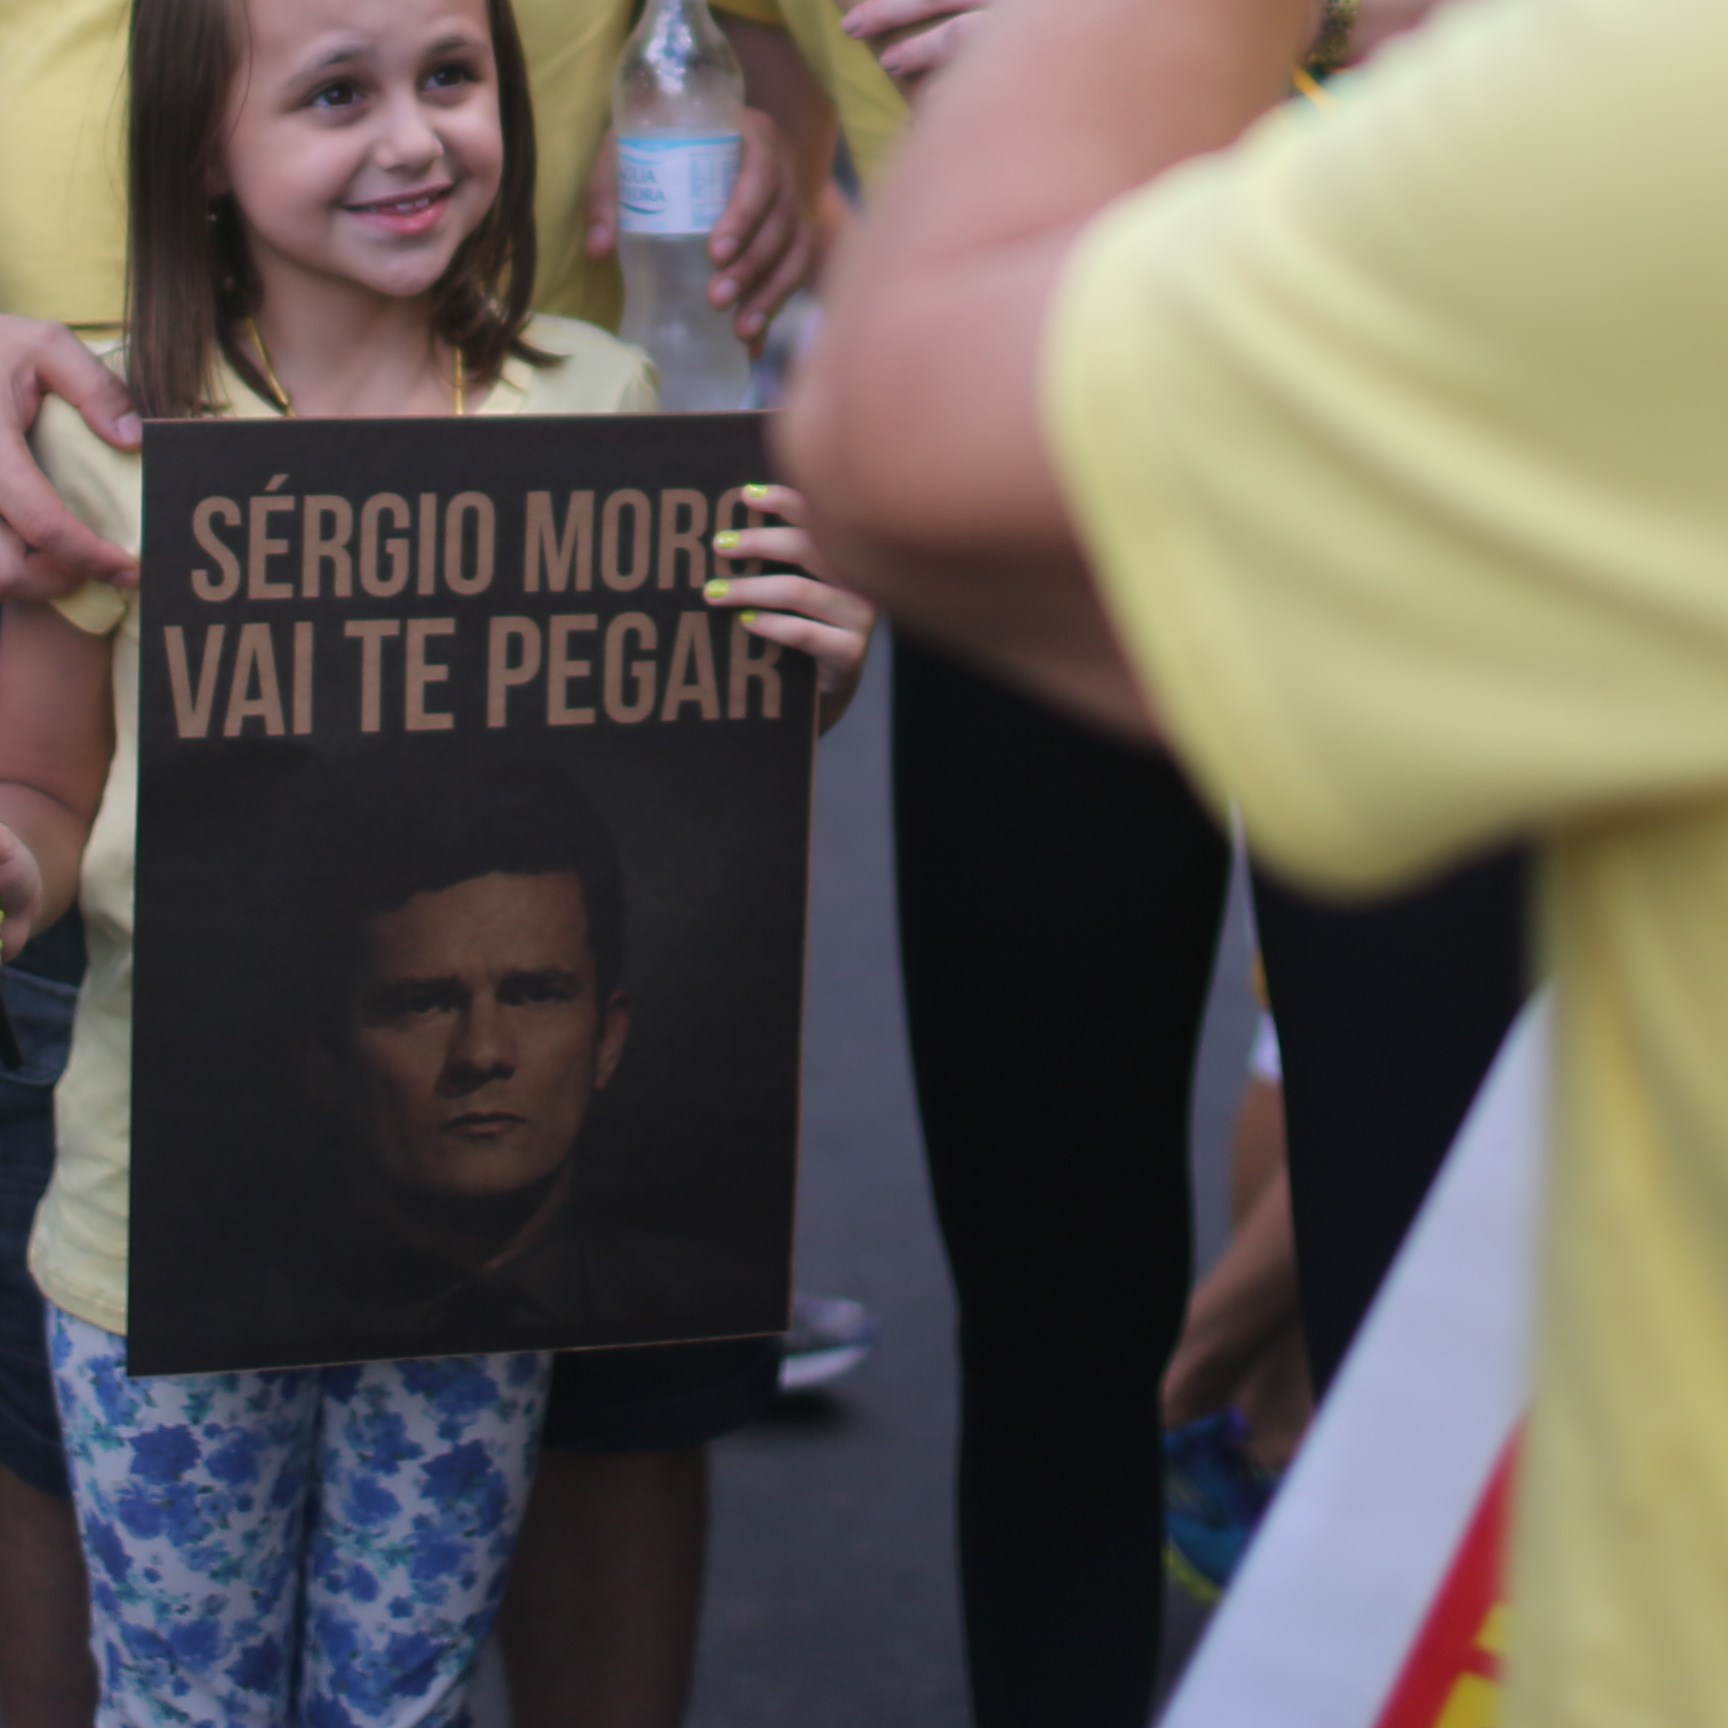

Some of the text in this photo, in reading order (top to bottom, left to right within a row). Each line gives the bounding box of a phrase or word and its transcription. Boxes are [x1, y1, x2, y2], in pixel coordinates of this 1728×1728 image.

[189, 472, 496, 603] SÉRGIO
[163, 610, 783, 740] VAI TE PEGAR
